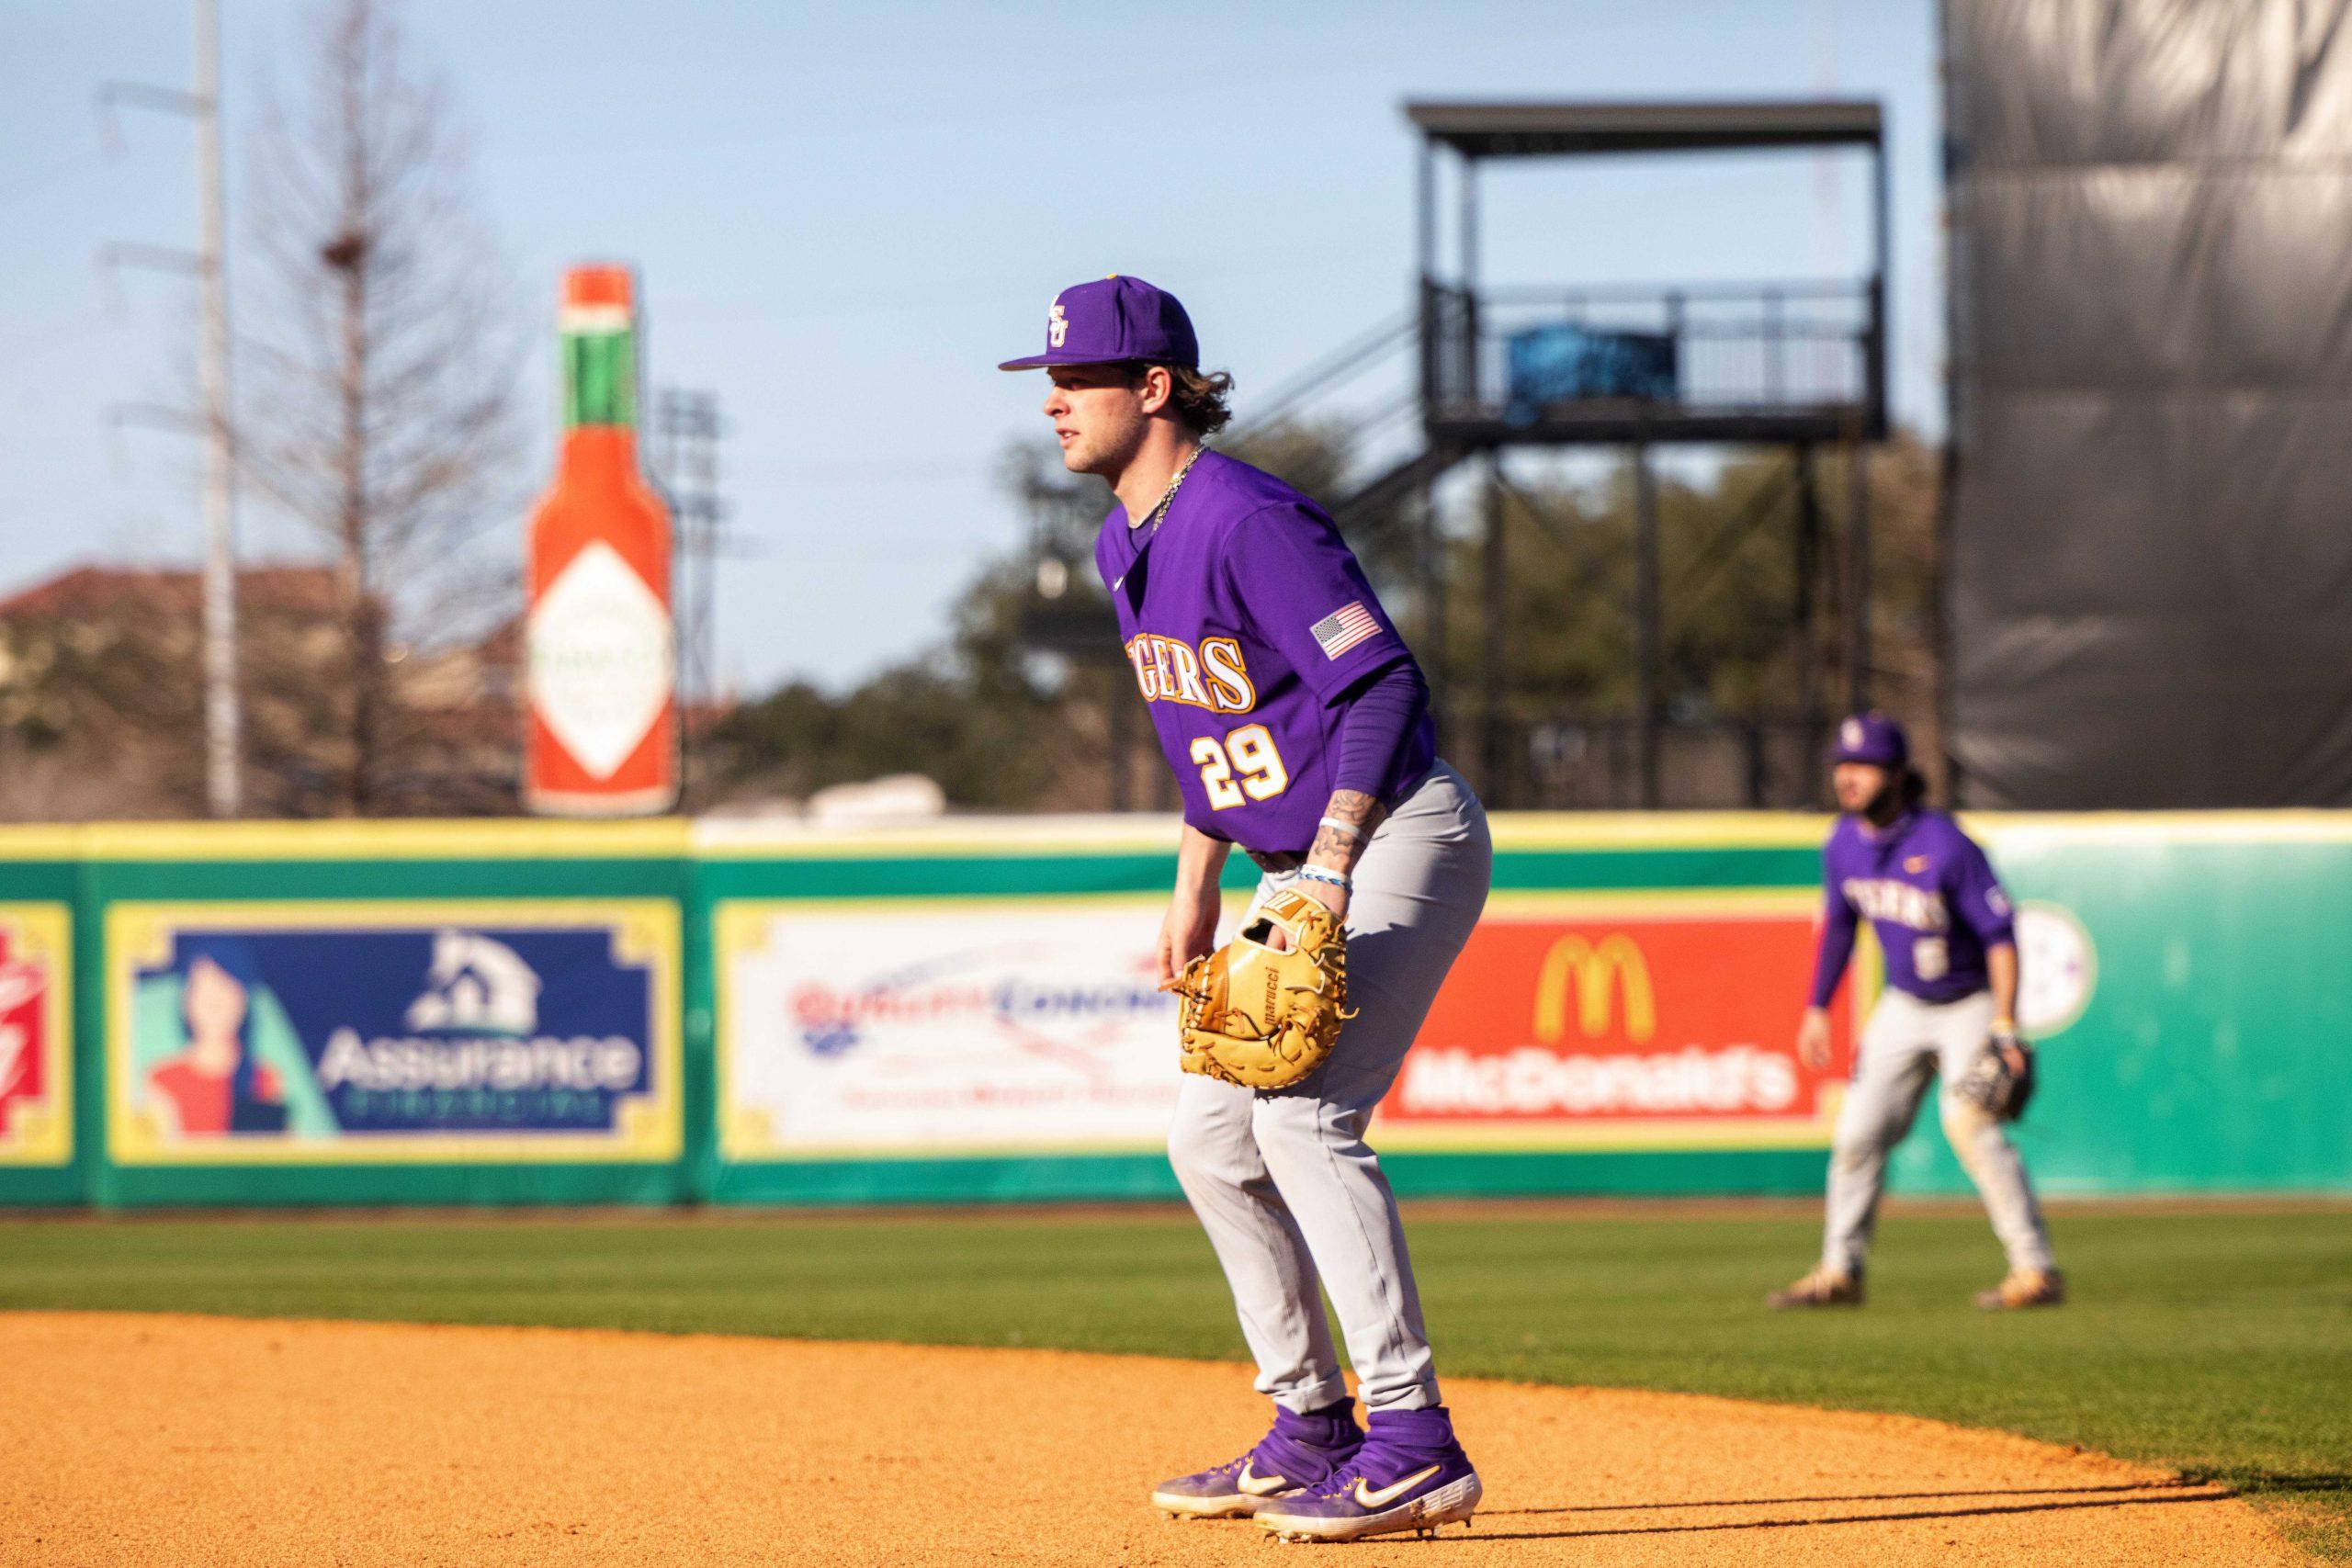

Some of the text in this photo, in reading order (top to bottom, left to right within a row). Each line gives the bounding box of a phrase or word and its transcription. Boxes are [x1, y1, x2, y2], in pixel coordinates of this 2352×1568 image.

[1125, 633, 1256, 714] GERS
[1190, 724, 1288, 811] 29
[1263, 966, 1281, 1026] marucci
[317, 1028, 641, 1091] Assurance
[1403, 1045, 1798, 1113] McDonald's
